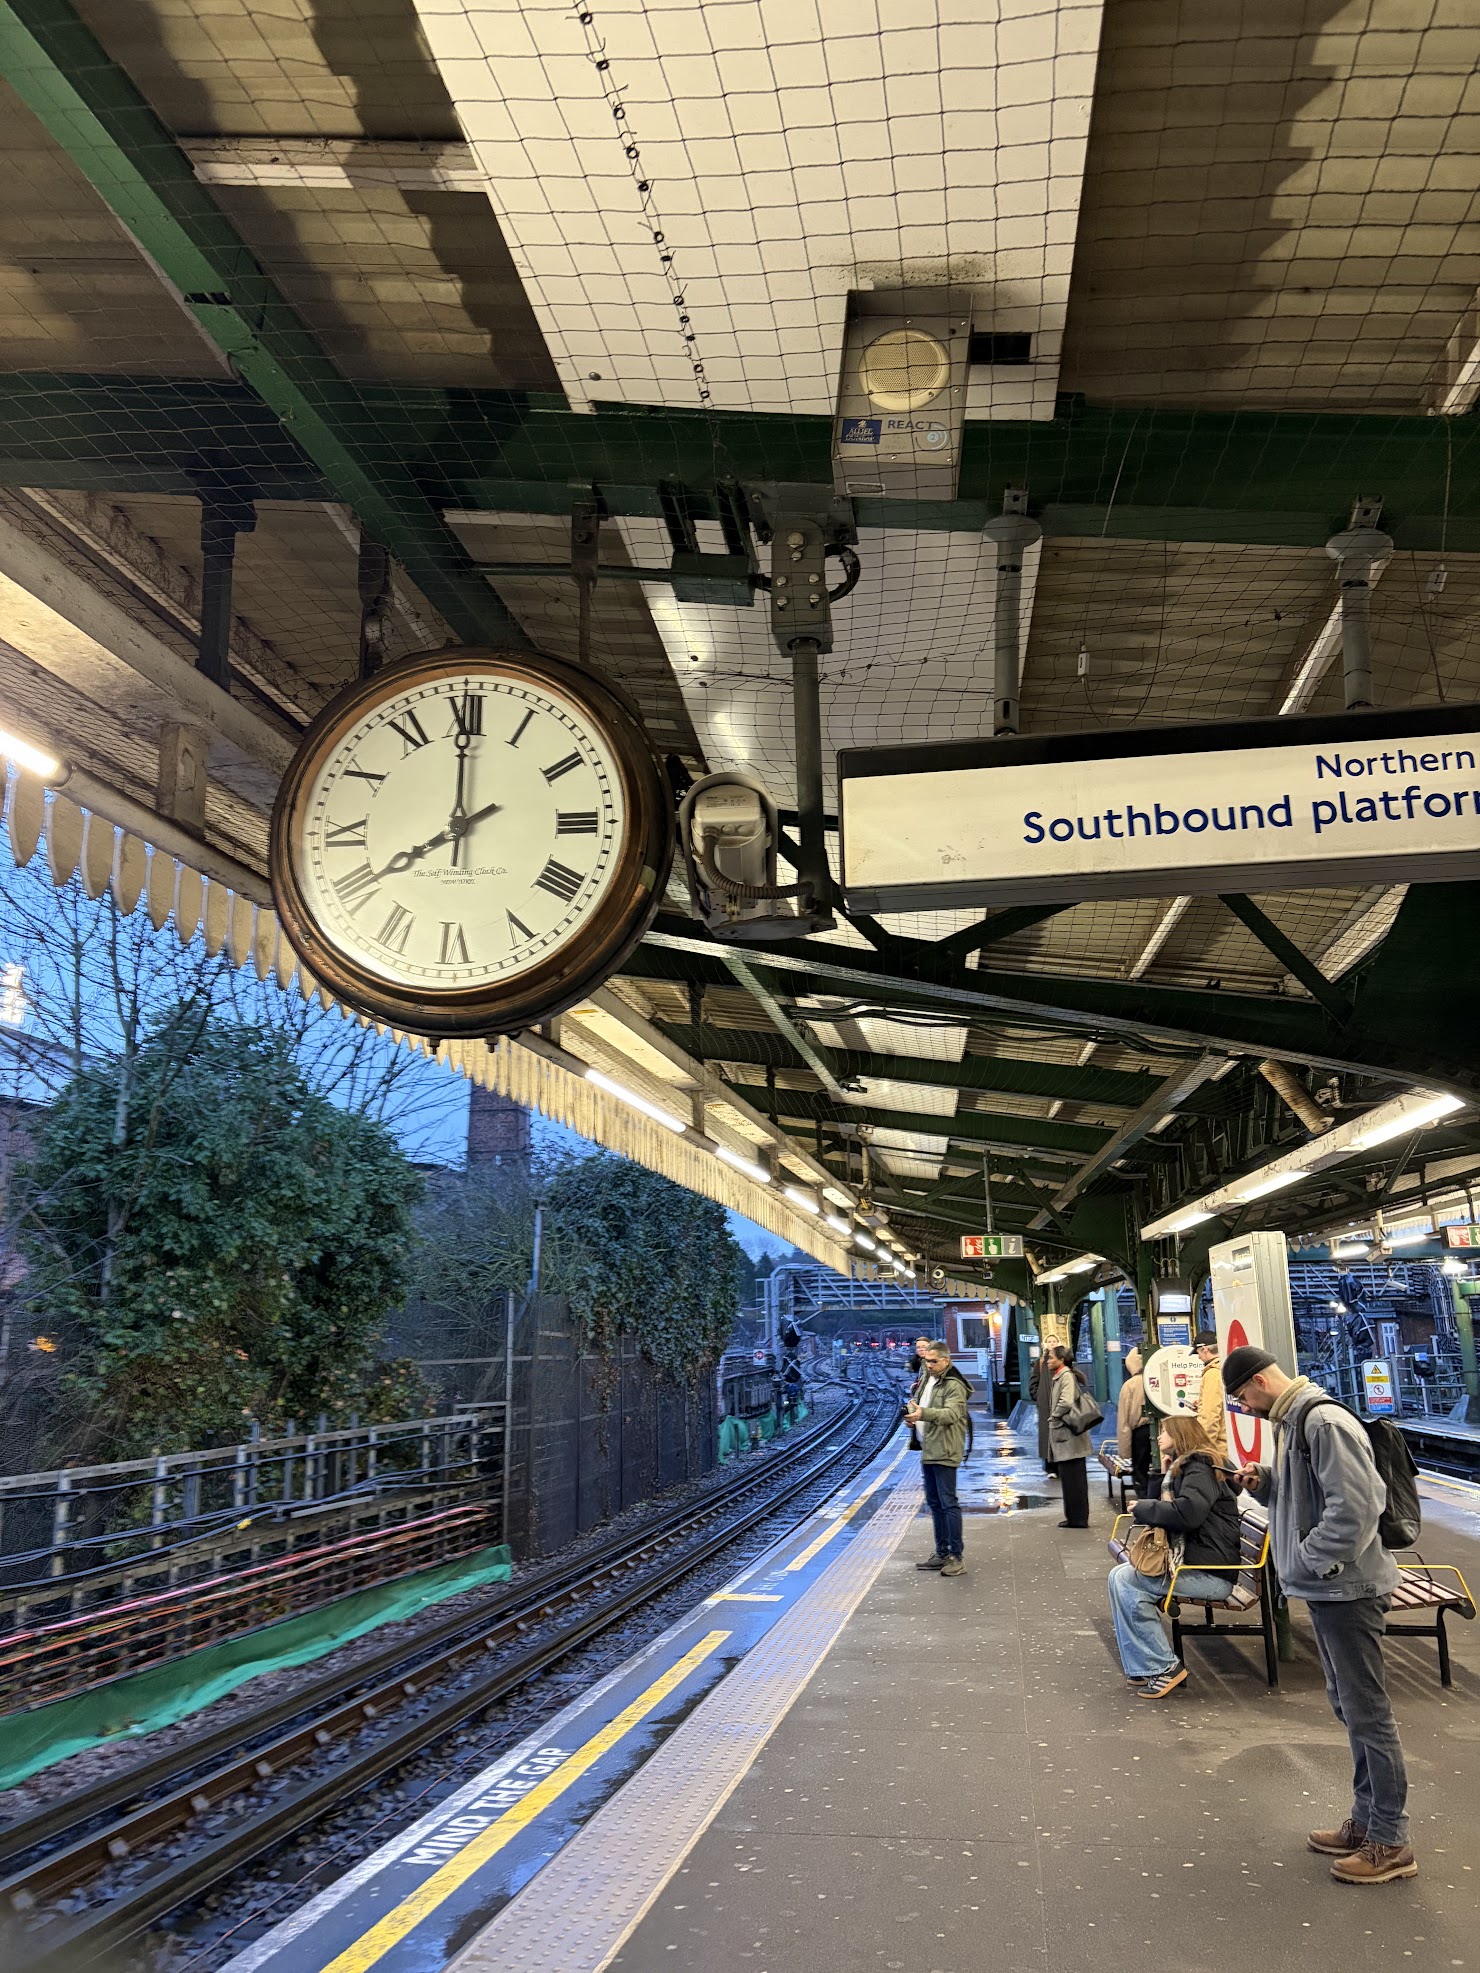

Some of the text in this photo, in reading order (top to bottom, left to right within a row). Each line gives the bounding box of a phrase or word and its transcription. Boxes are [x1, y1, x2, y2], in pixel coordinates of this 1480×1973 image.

[887, 419, 932, 430] REACT
[339, 753, 391, 798] X
[539, 746, 587, 788] II
[1315, 749, 1476, 778] Northern
[554, 806, 600, 839] III
[1023, 794, 1293, 844] Southbound
[504, 906, 541, 951] V
[1171, 1362, 1188, 1370] Help
[401, 1747, 572, 1866] MIND THE GAP
